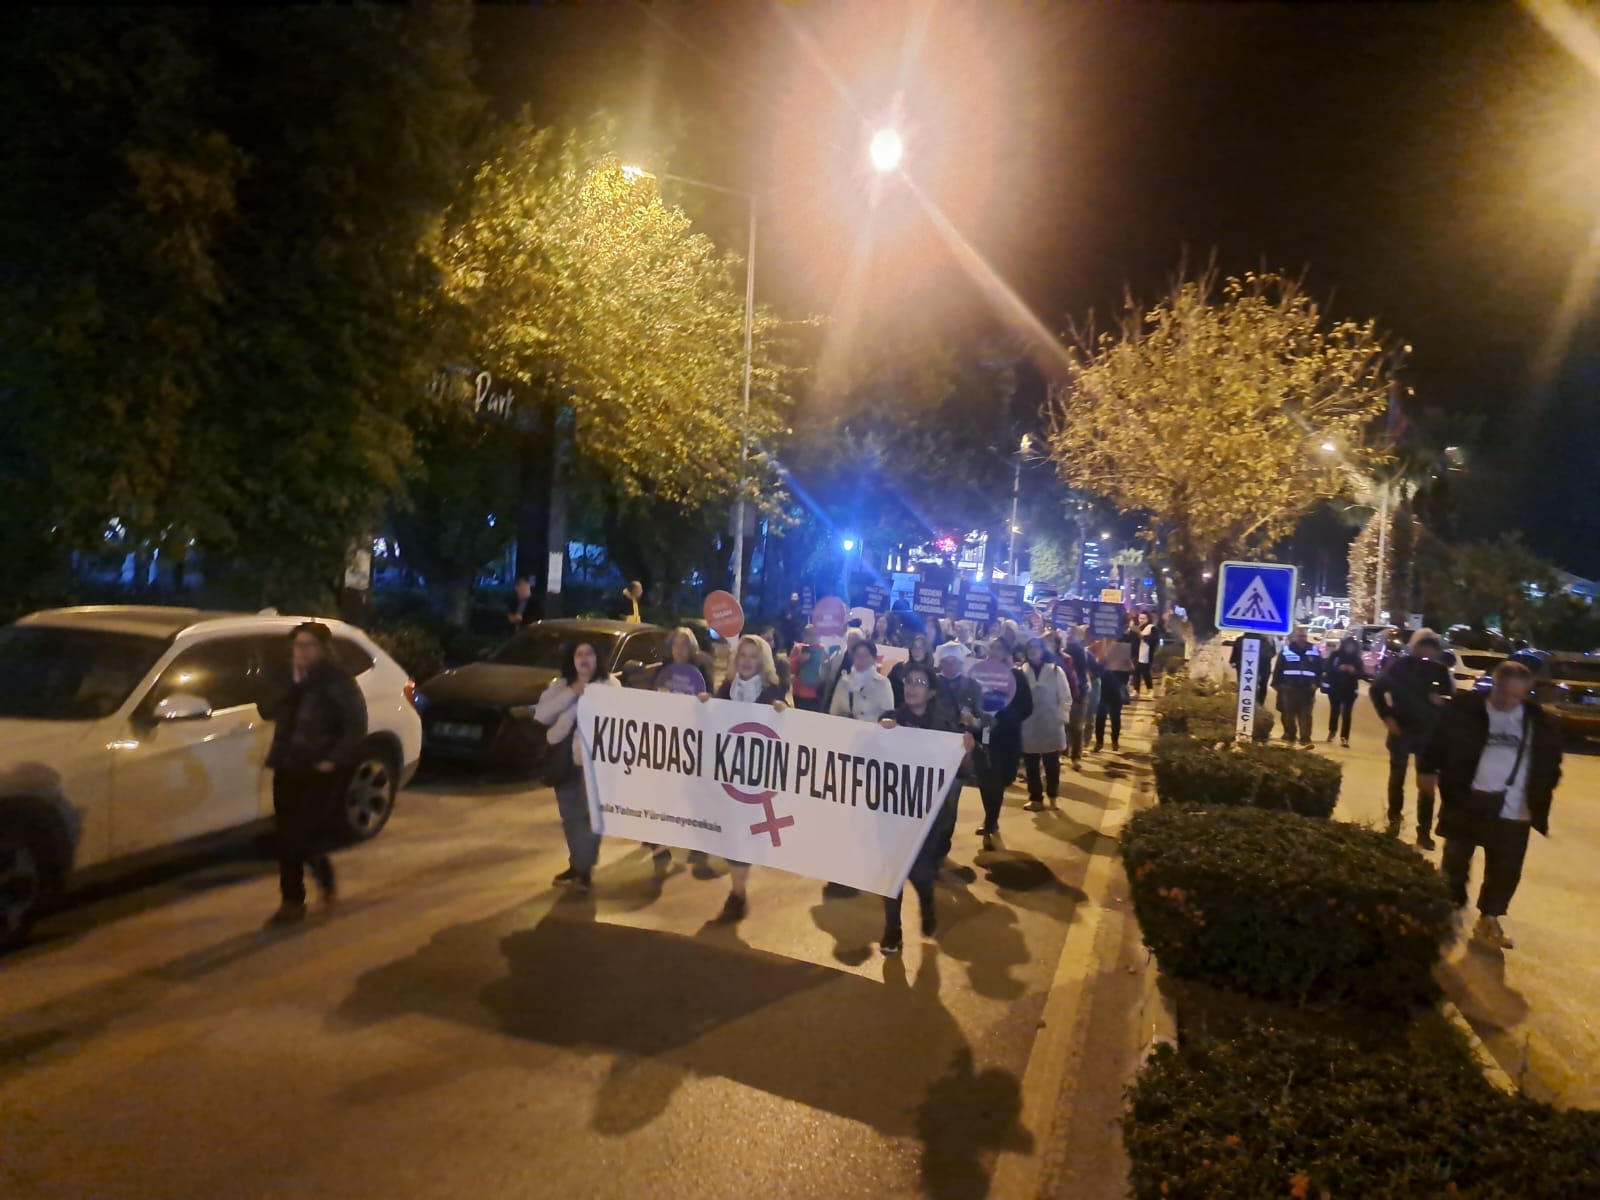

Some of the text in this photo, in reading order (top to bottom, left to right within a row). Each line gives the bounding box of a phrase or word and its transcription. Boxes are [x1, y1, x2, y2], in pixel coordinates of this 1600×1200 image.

[1243, 659, 1255, 691] YAYA
[591, 715, 703, 776] KUŞADASI
[714, 733, 789, 791] KADIN
